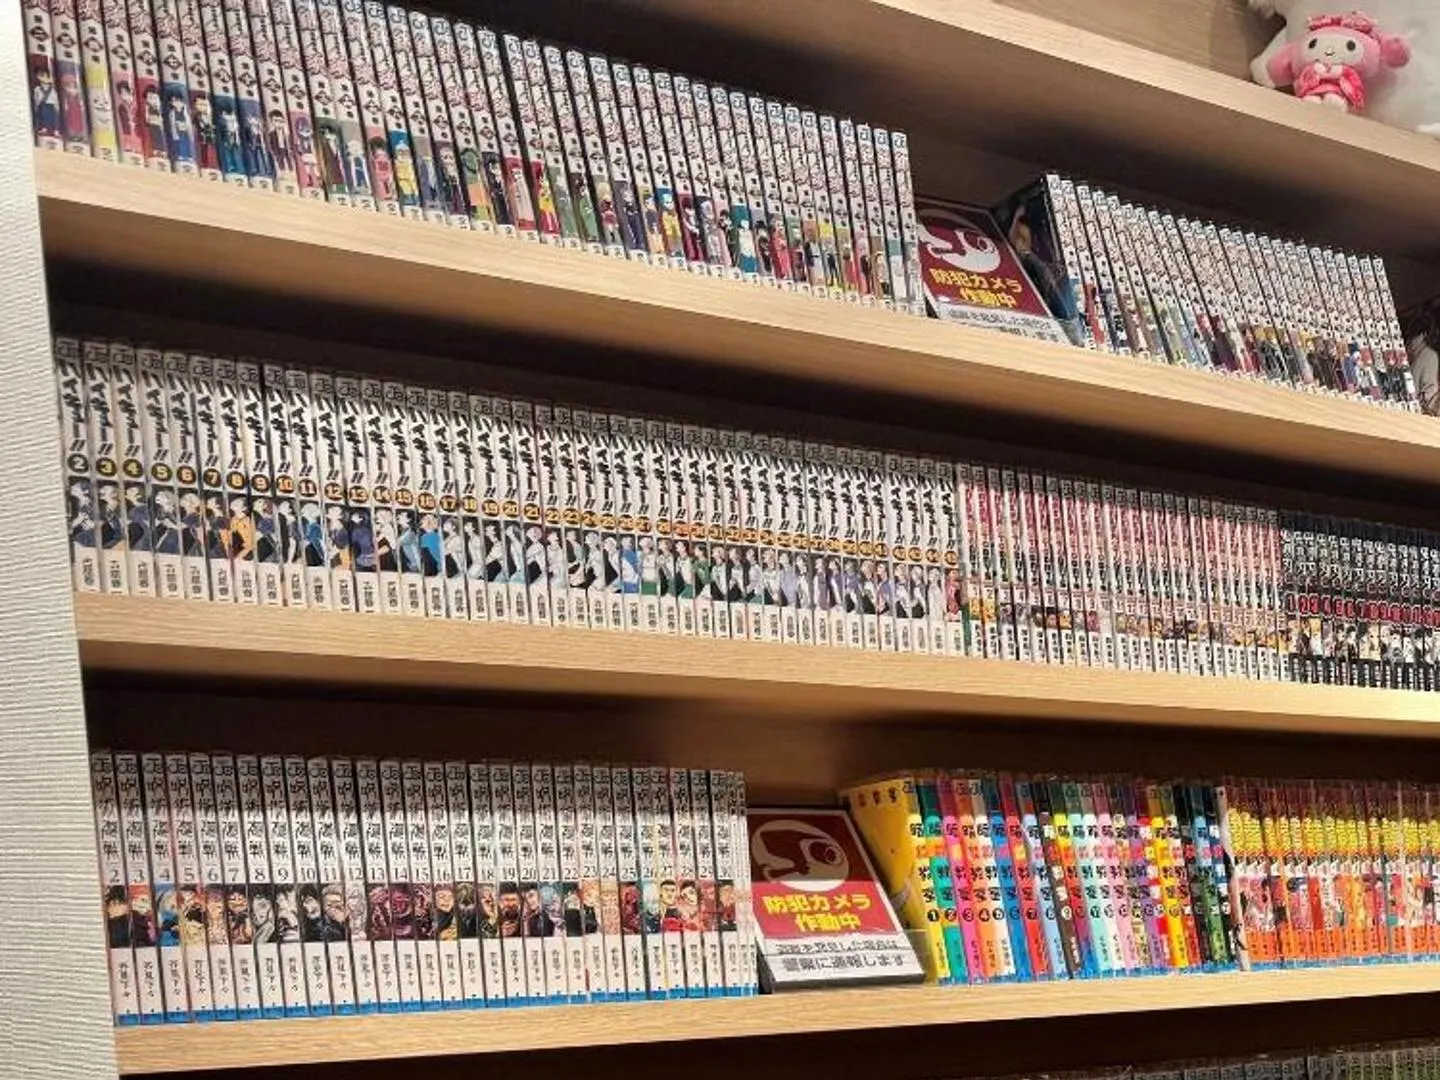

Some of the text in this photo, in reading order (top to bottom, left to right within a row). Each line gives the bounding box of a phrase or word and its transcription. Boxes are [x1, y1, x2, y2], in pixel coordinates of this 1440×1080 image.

[762, 894, 871, 914] 防犯カメラ
[796, 912, 860, 932] 作動中
